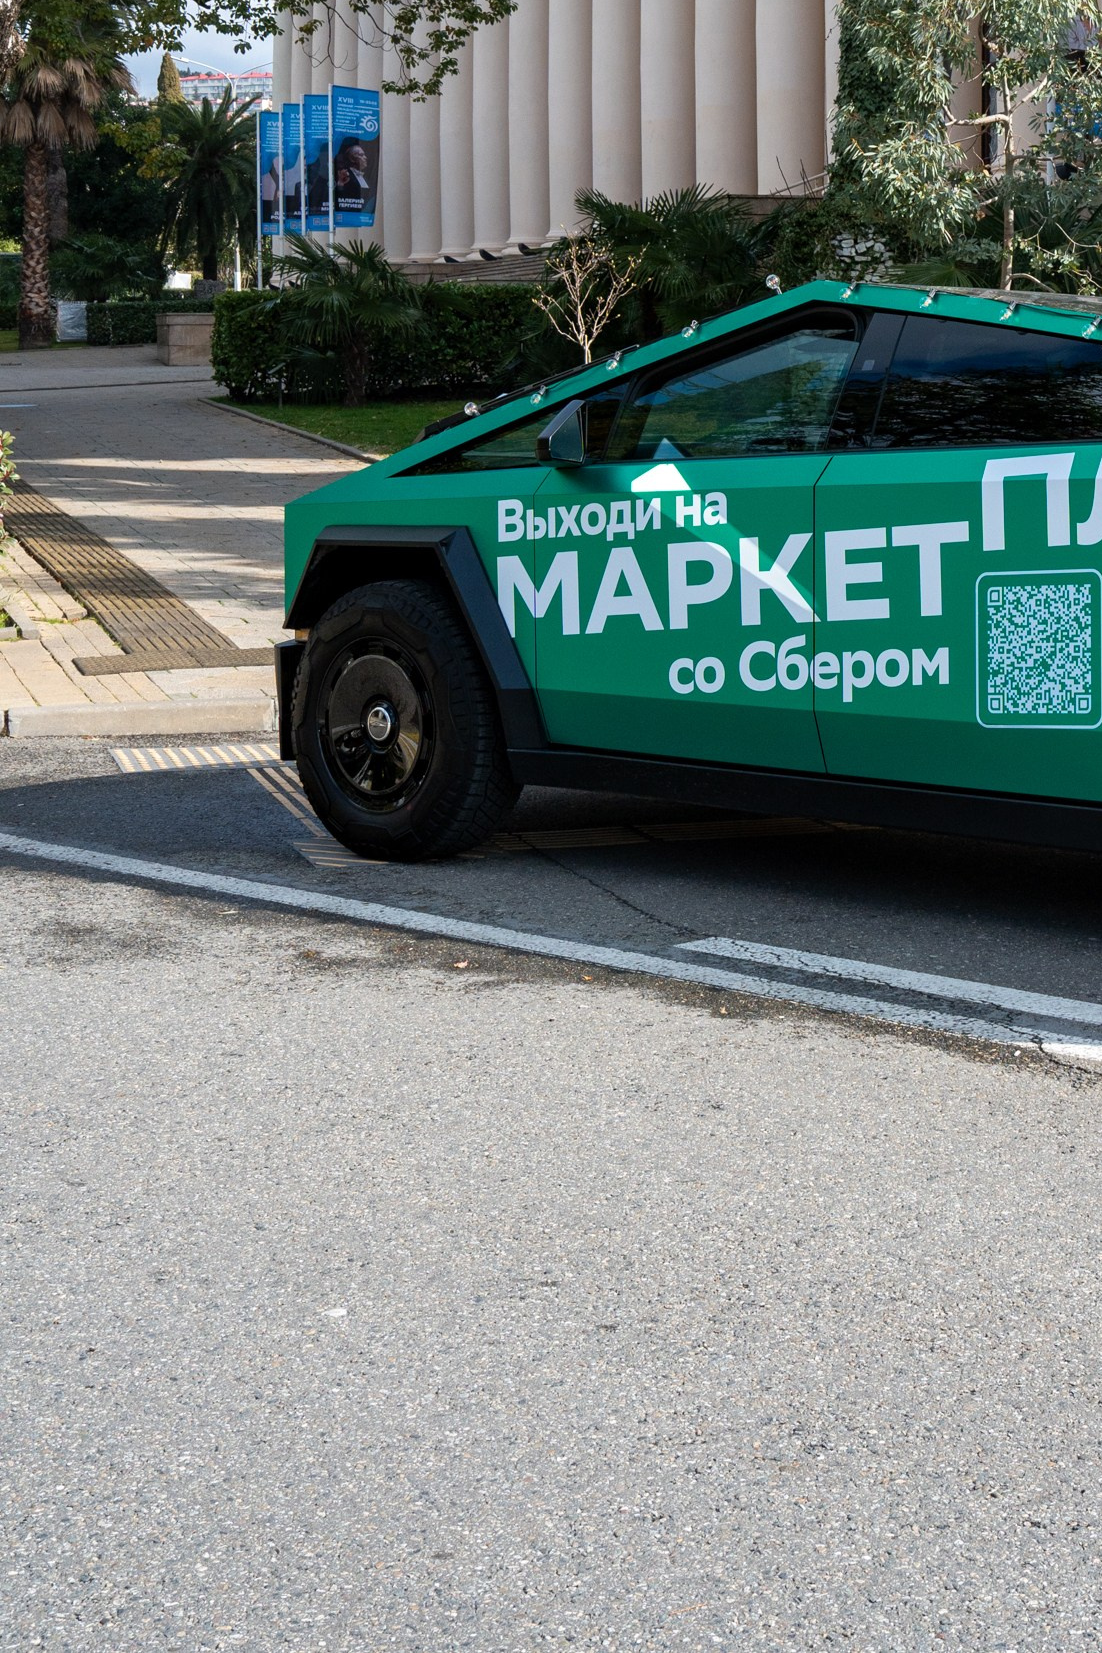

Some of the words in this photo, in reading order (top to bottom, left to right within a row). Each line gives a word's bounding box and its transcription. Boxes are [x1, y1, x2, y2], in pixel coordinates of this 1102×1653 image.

[497, 498, 661, 542] Выходи
[675, 491, 728, 528] на
[668, 656, 726, 695] со
[739, 634, 950, 703] Сбером
